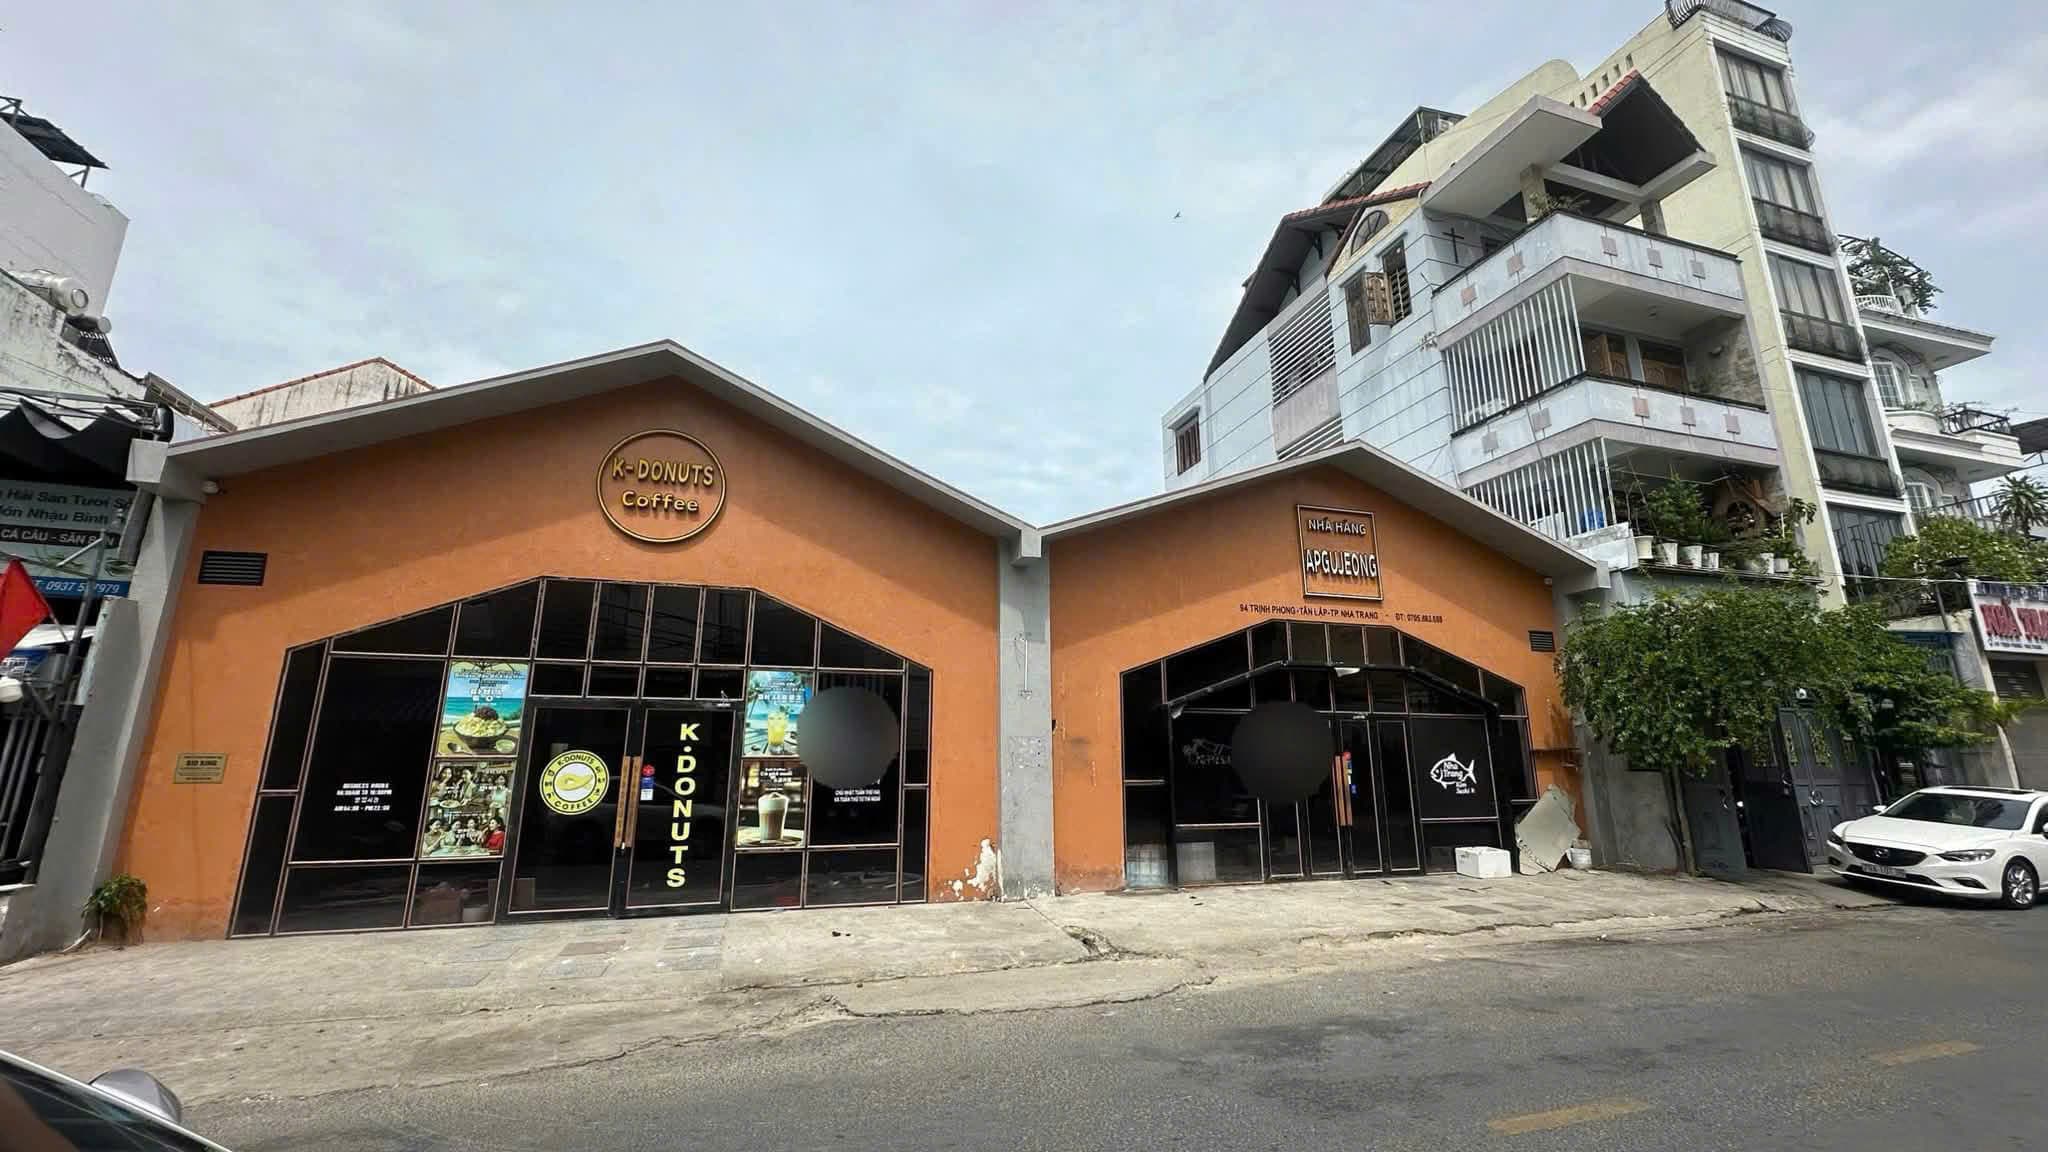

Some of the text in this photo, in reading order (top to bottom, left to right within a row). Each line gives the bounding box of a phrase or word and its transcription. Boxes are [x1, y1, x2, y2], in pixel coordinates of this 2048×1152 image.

[612, 457, 713, 486] K-DONUTS
[622, 491, 699, 511] Coffee
[1306, 549, 1377, 577] APGUJEONG
[46, 581, 74, 591] 0937
[1355, 610, 1378, 619] TRANG
[554, 798, 594, 811] COFFEE
